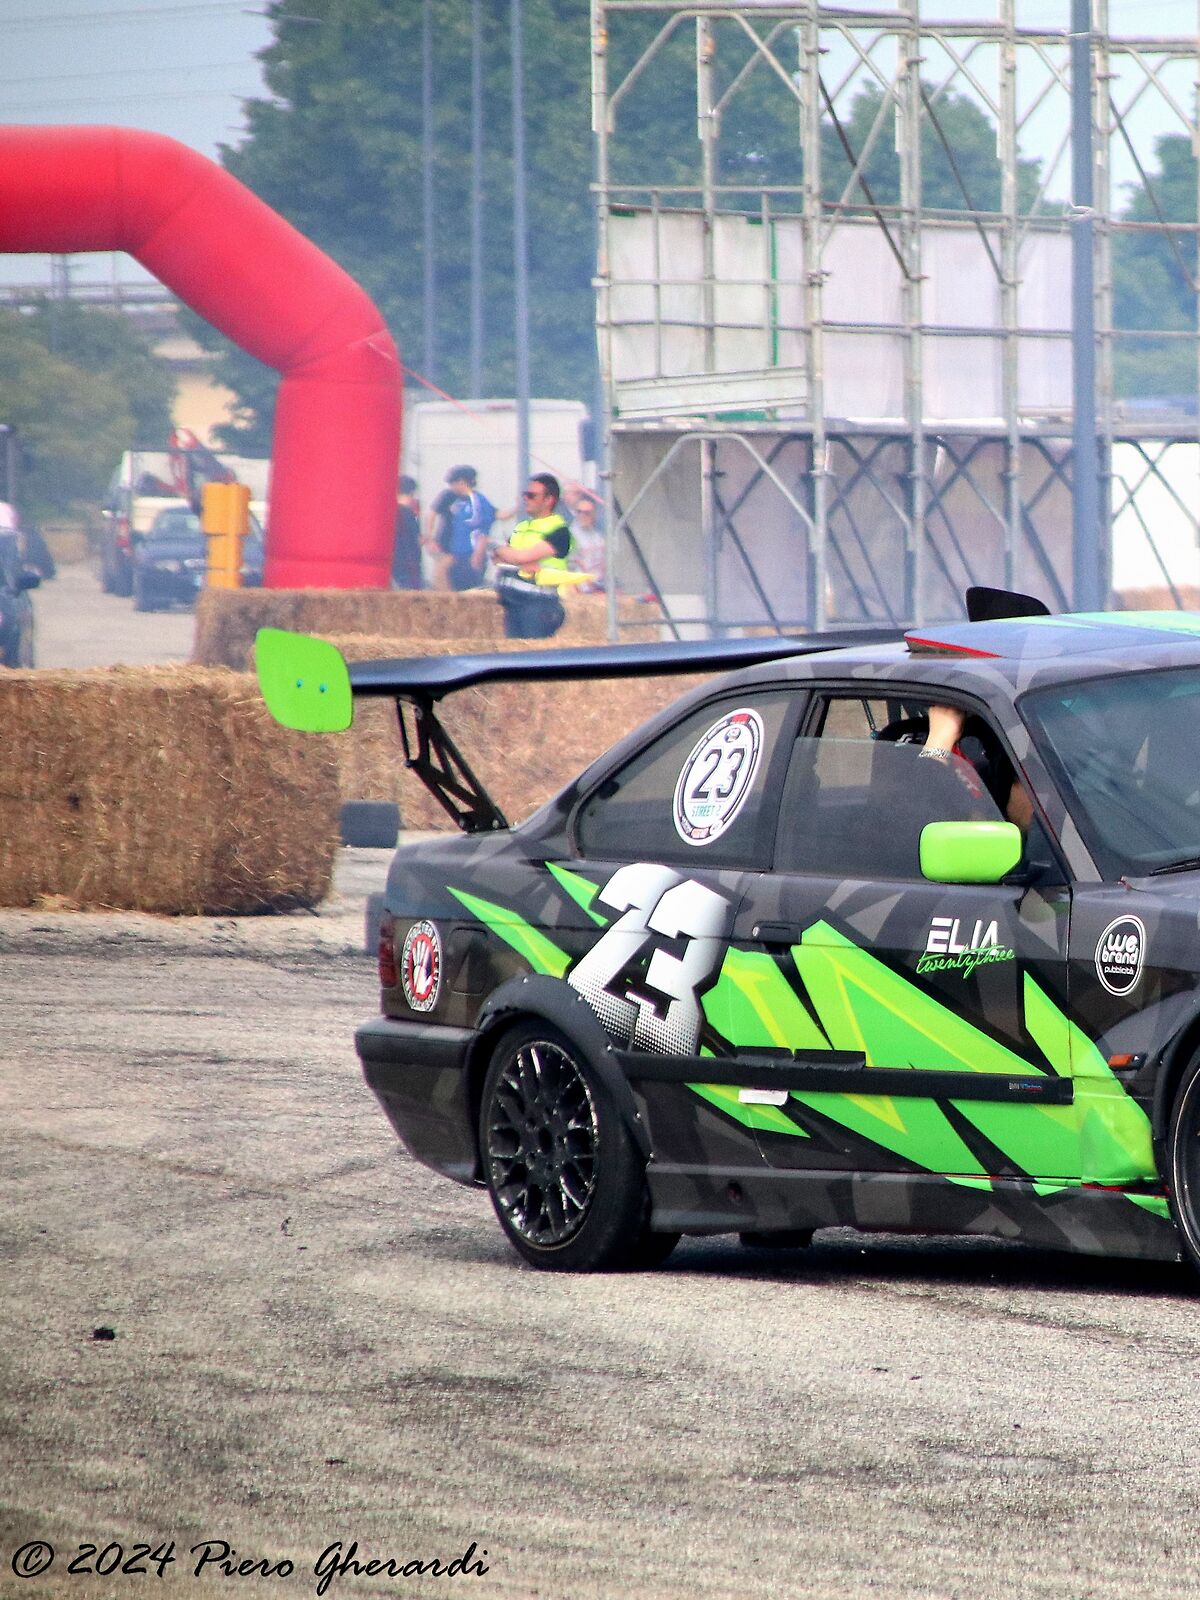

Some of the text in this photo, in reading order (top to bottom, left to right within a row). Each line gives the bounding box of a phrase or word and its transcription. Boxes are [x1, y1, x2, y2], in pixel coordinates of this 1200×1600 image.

[689, 747, 747, 800] 23
[926, 917, 999, 956] ELIA
[1102, 944, 1140, 965] brand
[1107, 933, 1138, 953] we
[567, 862, 732, 1056] 23
[915, 943, 1016, 980] twentythree
